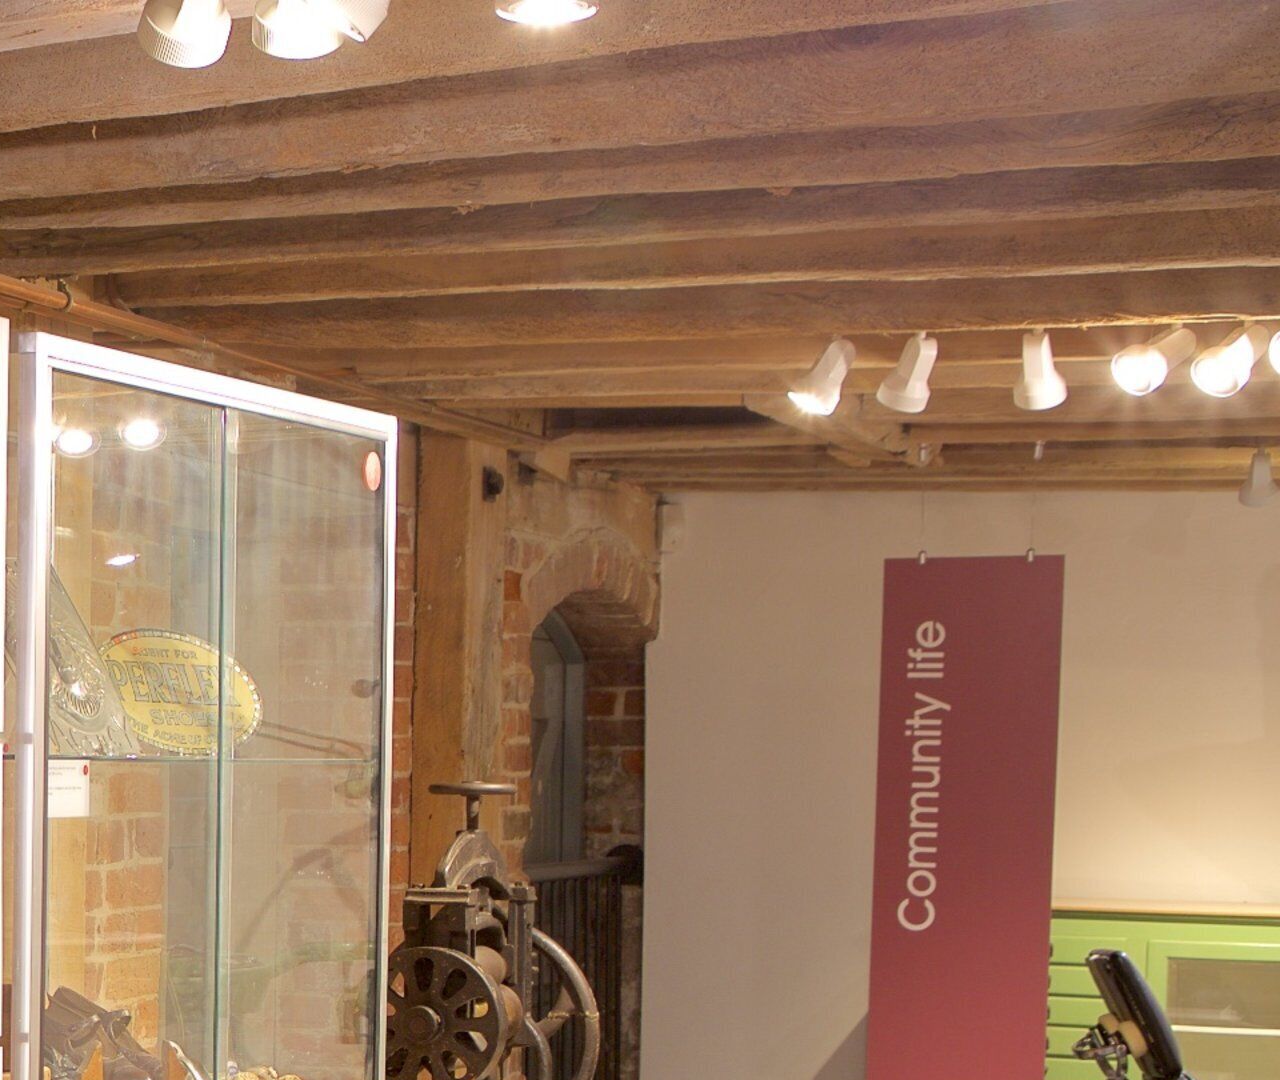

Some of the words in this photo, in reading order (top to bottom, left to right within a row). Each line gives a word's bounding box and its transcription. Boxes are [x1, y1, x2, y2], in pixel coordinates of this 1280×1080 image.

[175, 650, 197, 660] FOR
[907, 620, 946, 679] life
[898, 692, 951, 932] Community
